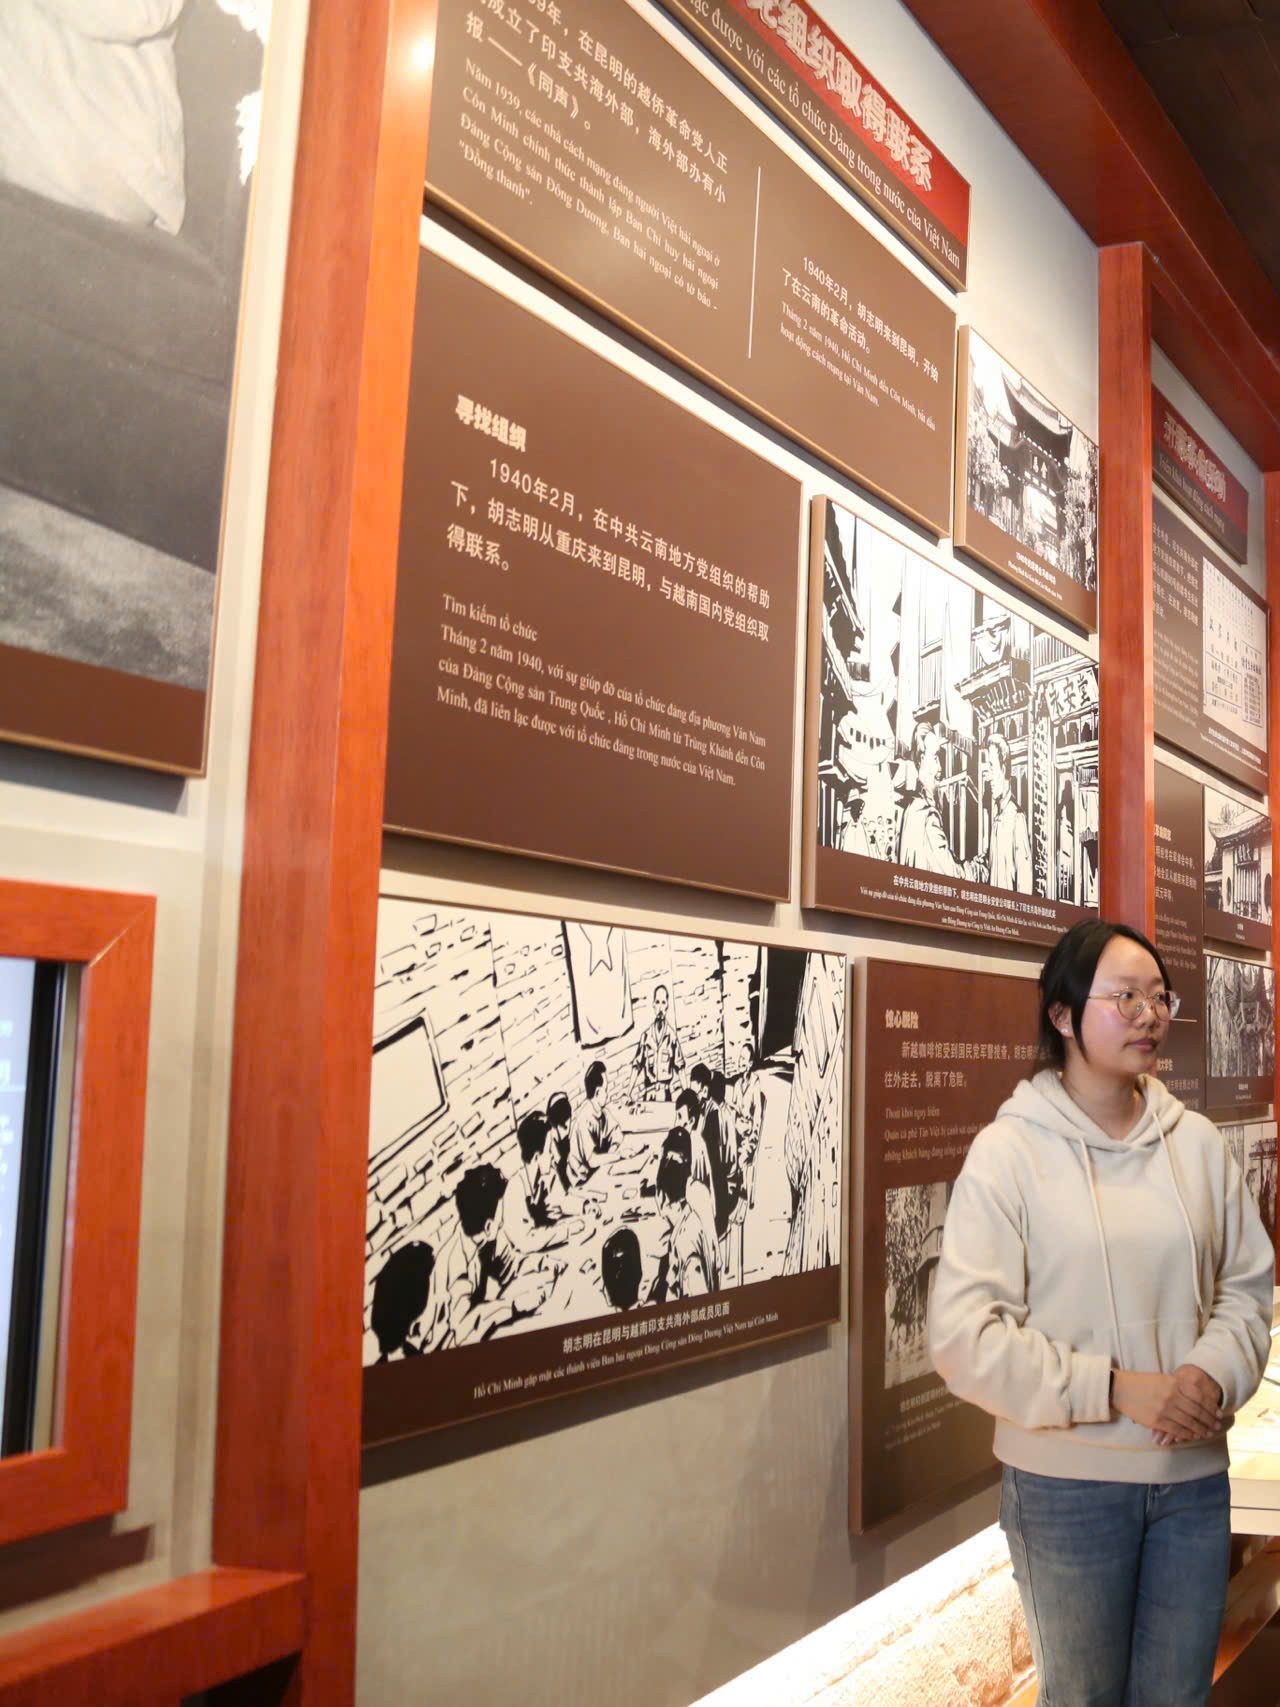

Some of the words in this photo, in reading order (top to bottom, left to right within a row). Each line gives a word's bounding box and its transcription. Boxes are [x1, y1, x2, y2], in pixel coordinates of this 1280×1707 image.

[480, 0, 726, 202] 成立了印支共海外部，海外部办有小
[528, 0, 728, 174] 9年，在昆明的越侨革命党人正
[712, 8, 743, 51] được
[746, 45, 764, 73] với
[767, 68, 786, 94] các
[788, 82, 799, 107] tổ
[802, 101, 826, 135] chức
[829, 124, 855, 168] Đảng
[857, 155, 881, 194] trong
[883, 183, 904, 213] nước
[906, 208, 922, 230] của
[923, 218, 940, 249] Việt
[940, 237, 960, 268] Nam
[455, 395, 527, 452] 寻找组织
[446, 524, 509, 570] 得联系。
[450, 481, 769, 642] 下，胡志明从重庆来到昆明，与越南国内党组织取
[489, 459, 770, 608] 1940年2月，在中共云南地方党组织的帮助
[443, 594, 466, 616] Tìm
[469, 603, 497, 627] kiếm
[499, 614, 510, 631] tổ
[512, 621, 538, 641] chức
[437, 686, 471, 711] Minh,
[474, 698, 489, 714] đã
[514, 708, 529, 727] lạc
[530, 715, 557, 735] được
[559, 725, 575, 739] với
[577, 729, 587, 742] tổ
[589, 733, 612, 749] chức
[613, 739, 635, 760] đảng
[636, 748, 660, 767] trong
[682, 763, 697, 774] của
[698, 764, 715, 781] Việt
[715, 769, 736, 785] Nam.
[438, 660, 460, 675] của
[463, 663, 493, 689] Đảng
[495, 674, 525, 699] Cộng
[527, 688, 545, 701] sản
[548, 690, 577, 715] Trung
[579, 701, 605, 720] Quốc
[613, 712, 629, 727] Hồ
[649, 723, 671, 741] Minh
[708, 742, 733, 760] Khánh
[734, 751, 748, 765] đến
[749, 756, 765, 770] Côn
[441, 624, 477, 654] Tháng
[480, 638, 488, 653] 2
[490, 645, 513, 662] năm
[517, 651, 545, 674] 1940,
[547, 664, 564, 679] với
[565, 672, 578, 686] sự
[580, 674, 601, 694] giúp
[602, 681, 616, 696] đỡ
[617, 689, 633, 702] của
[634, 690, 644, 705] tổ
[645, 696, 666, 713] chức
[667, 703, 688, 723] đảng
[688, 710, 701, 726] địa
[702, 716, 731, 738] phương
[748, 731, 766, 747] Nam
